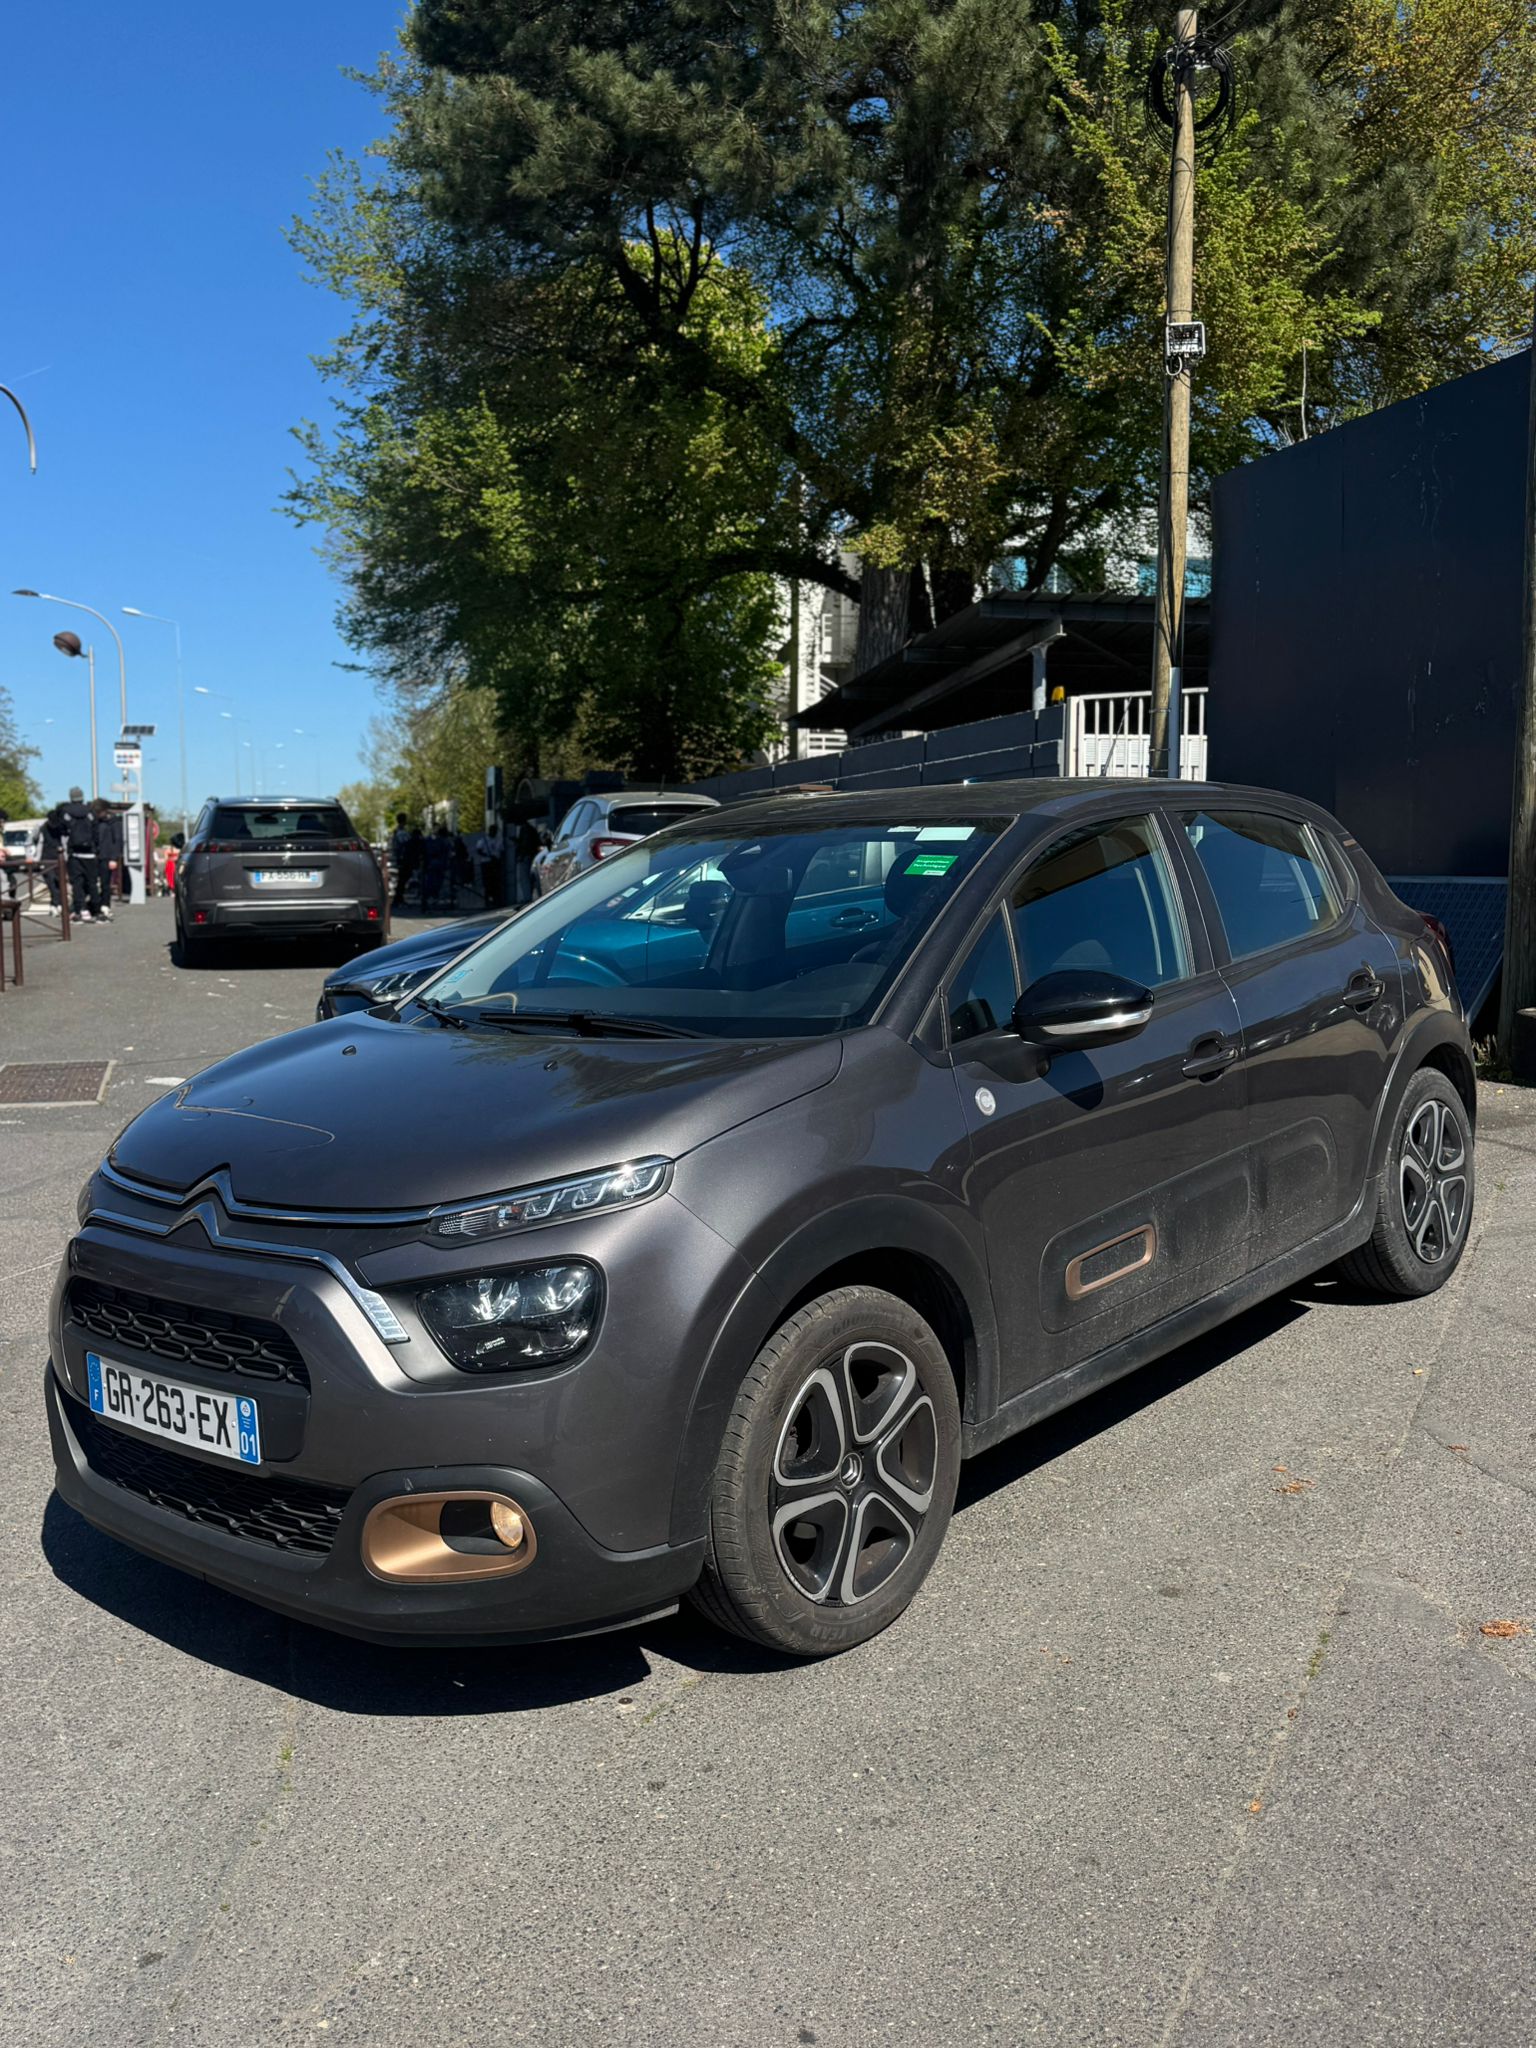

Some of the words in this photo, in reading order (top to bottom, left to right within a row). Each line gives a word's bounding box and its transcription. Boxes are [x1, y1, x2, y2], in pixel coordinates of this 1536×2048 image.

[94, 1389, 100, 1401] F
[105, 1367, 232, 1449] GR-263-EX
[240, 1431, 257, 1457] 01
